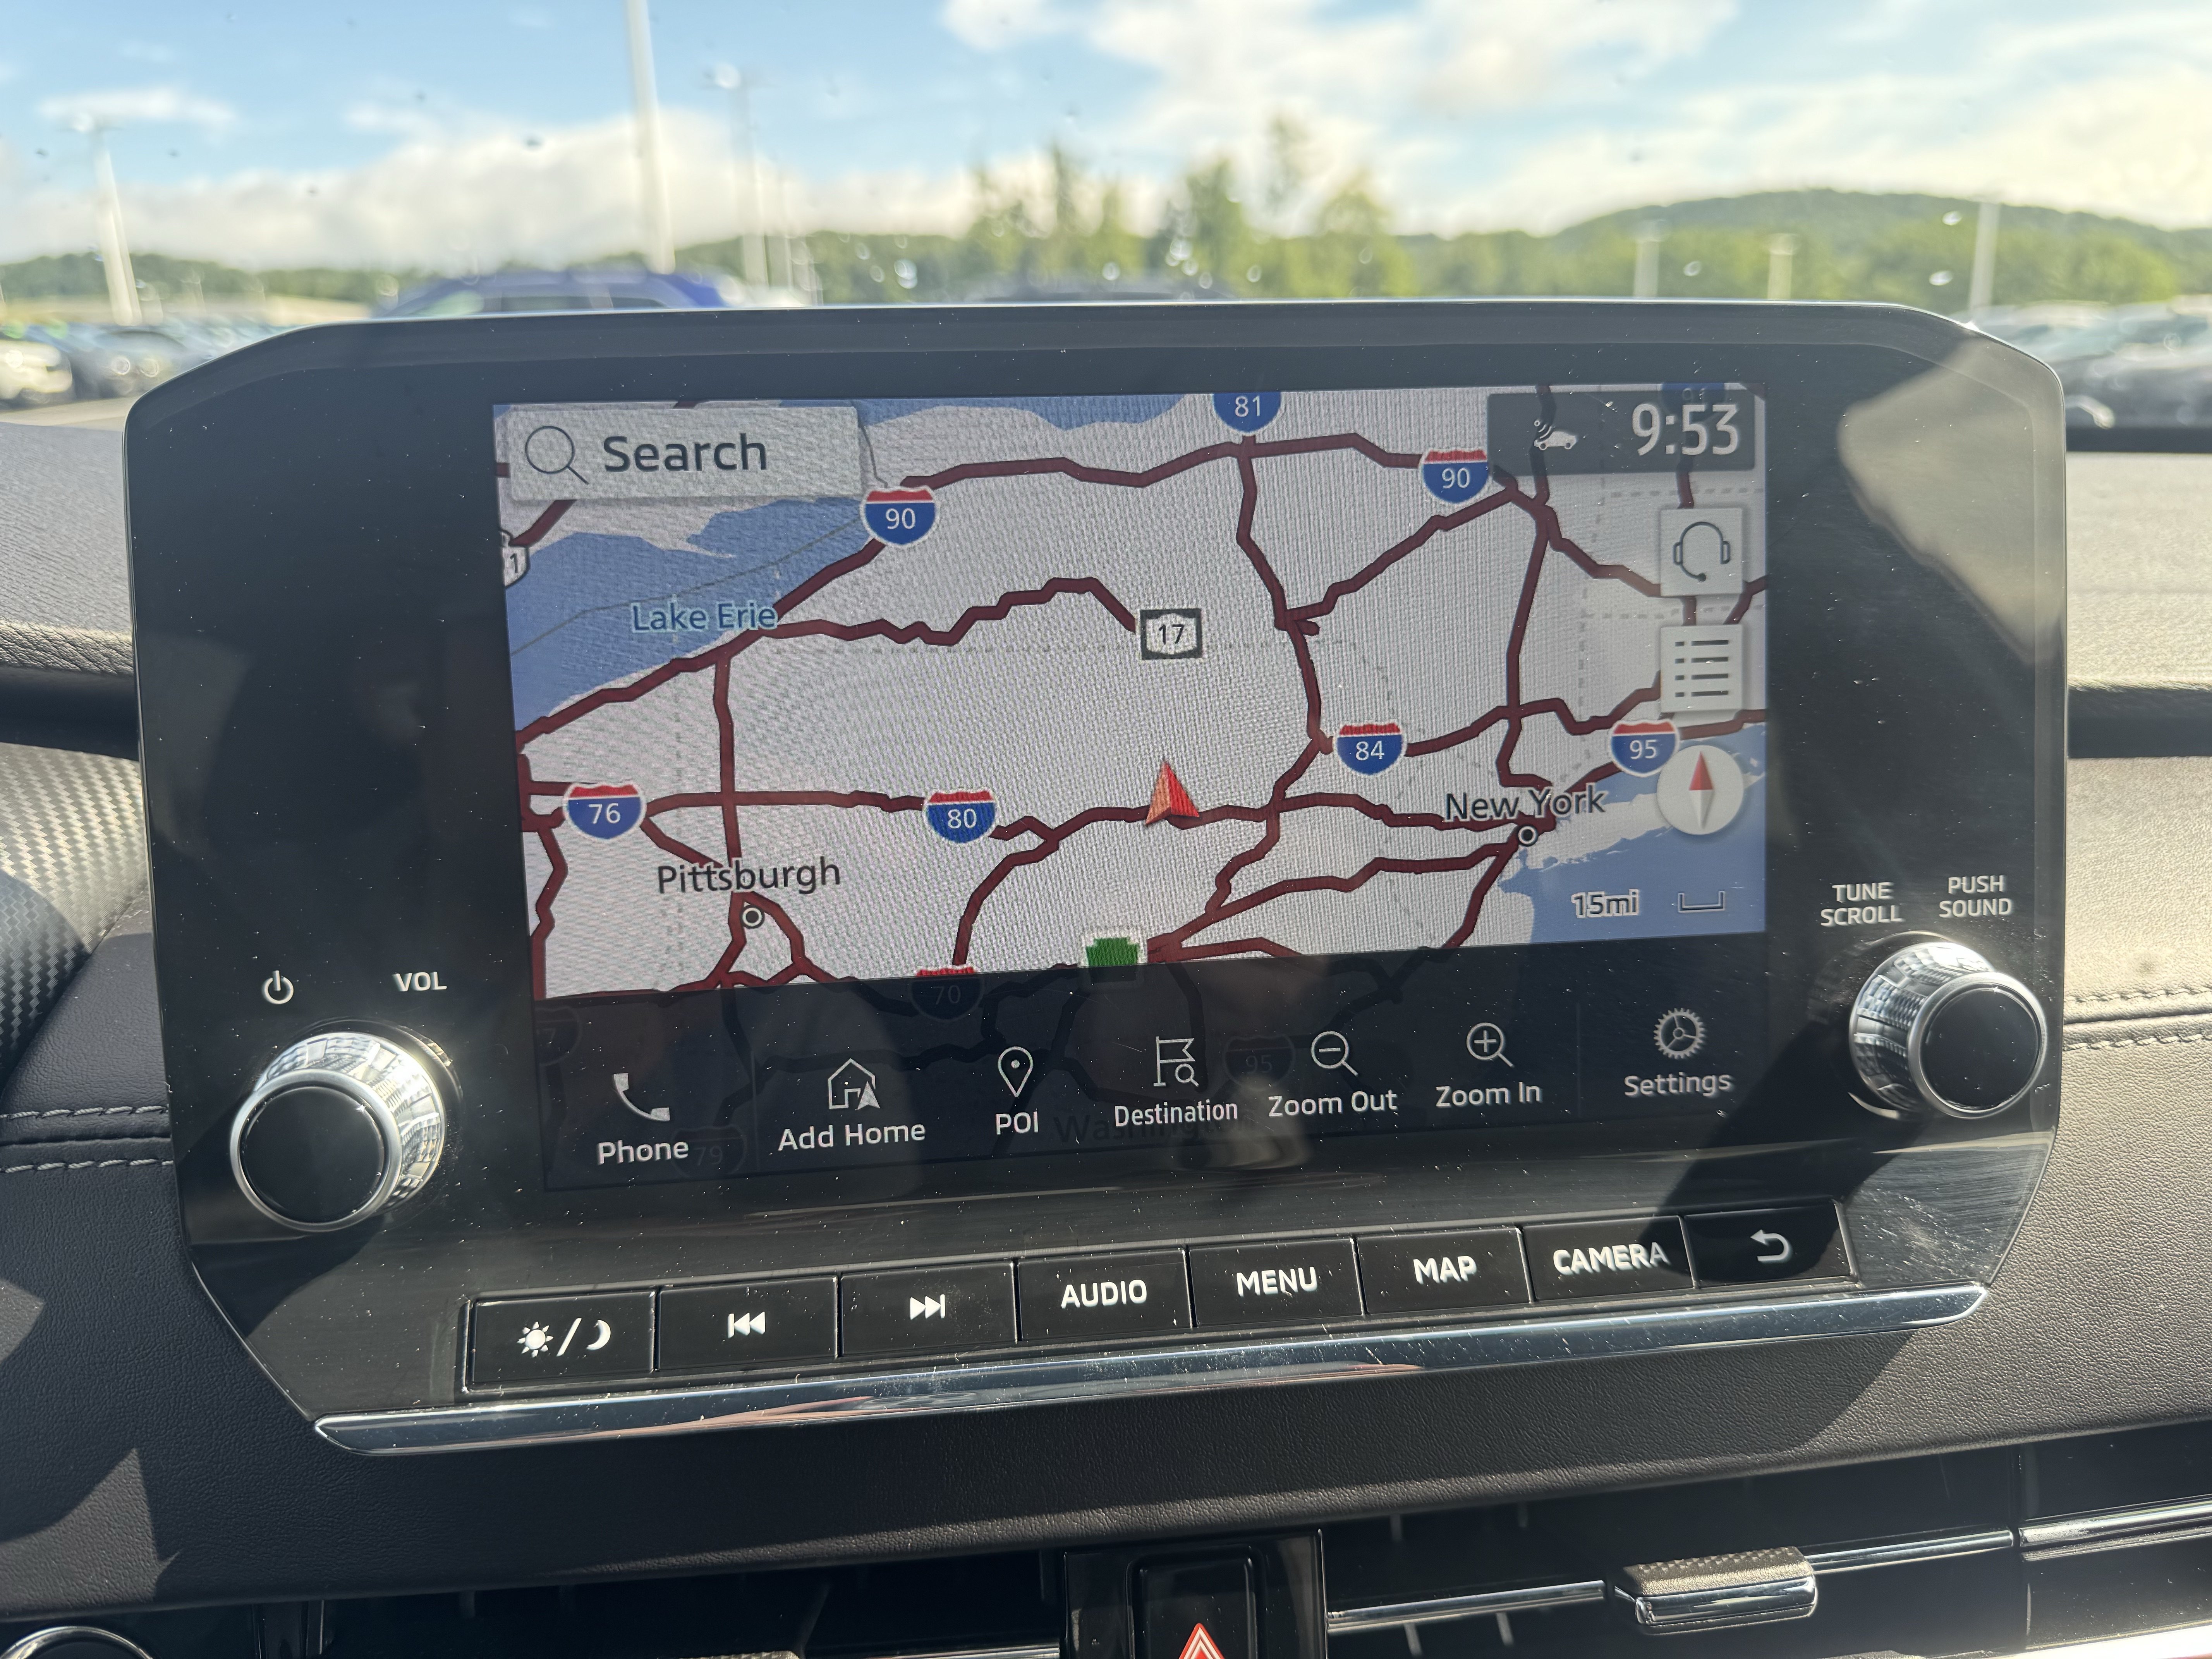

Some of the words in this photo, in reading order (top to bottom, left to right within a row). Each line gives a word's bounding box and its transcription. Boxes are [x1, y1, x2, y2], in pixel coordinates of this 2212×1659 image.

[1234, 396, 1262, 417] 81
[1632, 403, 1739, 456] 9:53
[603, 434, 767, 472] Search
[1442, 467, 1471, 489] 90
[885, 507, 916, 530] 90
[633, 603, 706, 630] Lake
[718, 601, 776, 629] Erie
[1158, 623, 1185, 647] 17
[1355, 740, 1385, 761] 84
[1629, 738, 1658, 760] 95
[588, 803, 621, 825] 76
[1446, 790, 1519, 820] New
[1527, 784, 1606, 816] York
[947, 808, 977, 830] 80
[658, 855, 841, 895] Pittsburgh
[1948, 875, 2005, 894] PUSH
[1832, 881, 1894, 902] TUNE
[1571, 889, 1639, 919] 15mi
[1820, 905, 1903, 927] SCROLL
[1939, 898, 2012, 918] SOUND
[393, 971, 447, 992] VOL
[931, 985, 961, 1006] 70
[1245, 1054, 1273, 1075] 95
[1436, 1083, 1510, 1108] Zoom
[1518, 1081, 1543, 1104] In
[1624, 1072, 1733, 1097] Settings
[1115, 1099, 1238, 1127] Destination
[1268, 1094, 1343, 1118] Zoom
[1351, 1089, 1398, 1112] Out
[996, 1111, 1039, 1135] POI
[778, 1125, 834, 1152] Add
[845, 1120, 926, 1147] Home
[598, 1140, 689, 1165] Phone
[695, 1144, 723, 1167] 79
[1413, 1255, 1477, 1284] MAP
[1553, 1242, 1669, 1276] CAMERA
[1236, 1266, 1318, 1297] MENU
[1061, 1279, 1147, 1309] AUDIO
